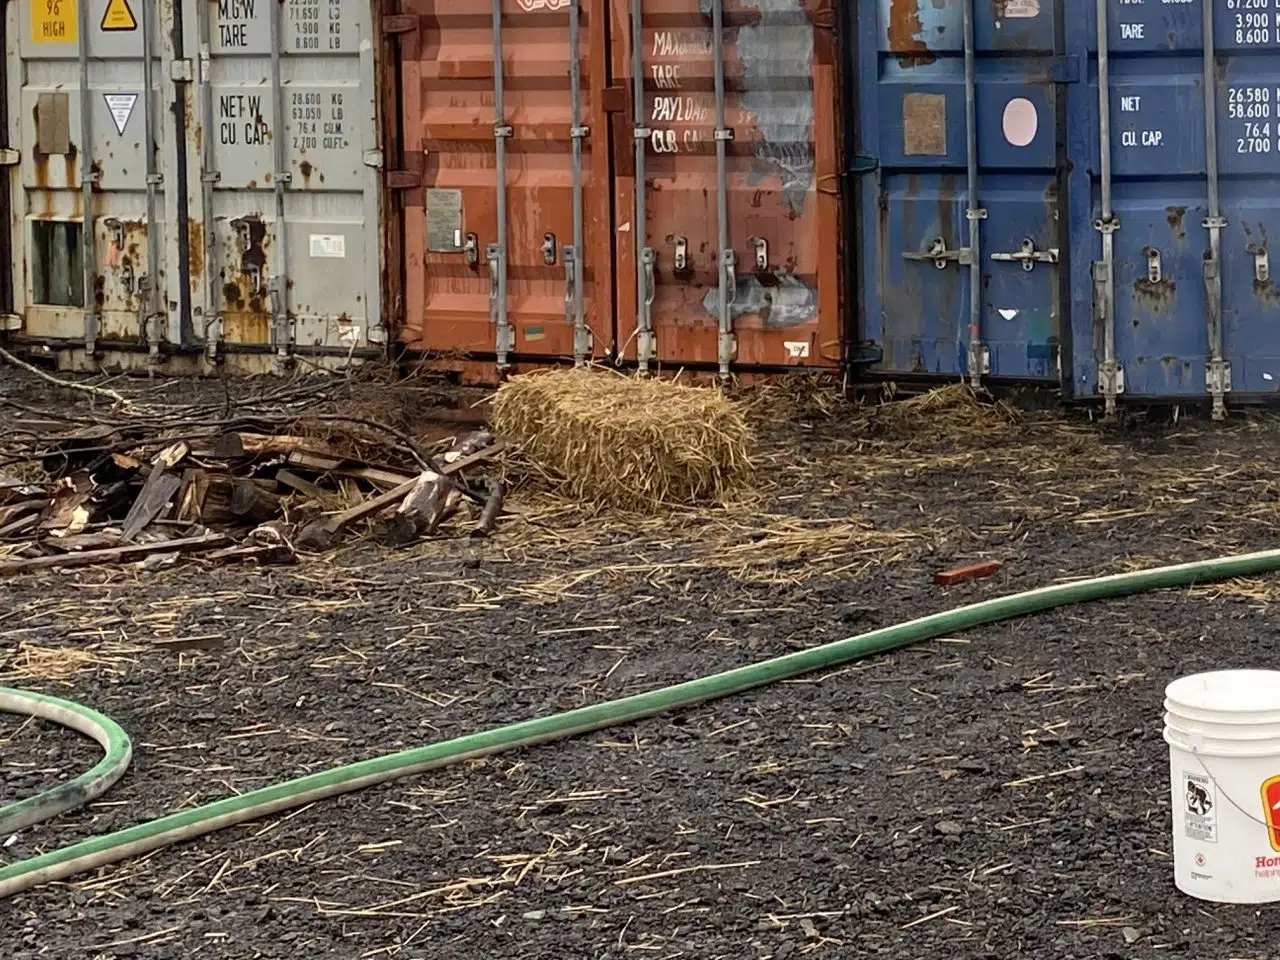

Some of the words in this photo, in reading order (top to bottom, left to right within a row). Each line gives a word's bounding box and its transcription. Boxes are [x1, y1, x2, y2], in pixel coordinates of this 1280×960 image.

[329, 22, 340, 34] KG
[1236, 13, 1268, 28] 3.900
[43, 21, 65, 37] HIGH
[218, 24, 247, 47] TARE
[1120, 24, 1144, 39] TARE
[1236, 29, 1269, 43] 8.600
[329, 37, 340, 49] LB
[651, 65, 683, 88] TARE
[332, 93, 343, 105] KG
[1229, 88, 1270, 102] 26.580
[220, 96, 244, 117] NET
[1121, 97, 1141, 112] NET
[1229, 104, 1270, 118] 58.600
[332, 108, 343, 120] LB
[1245, 122, 1270, 137] 76.4
[1122, 132, 1138, 146] CU.
[1142, 131, 1164, 146] CAP.
[1237, 138, 1271, 153] 2.700
